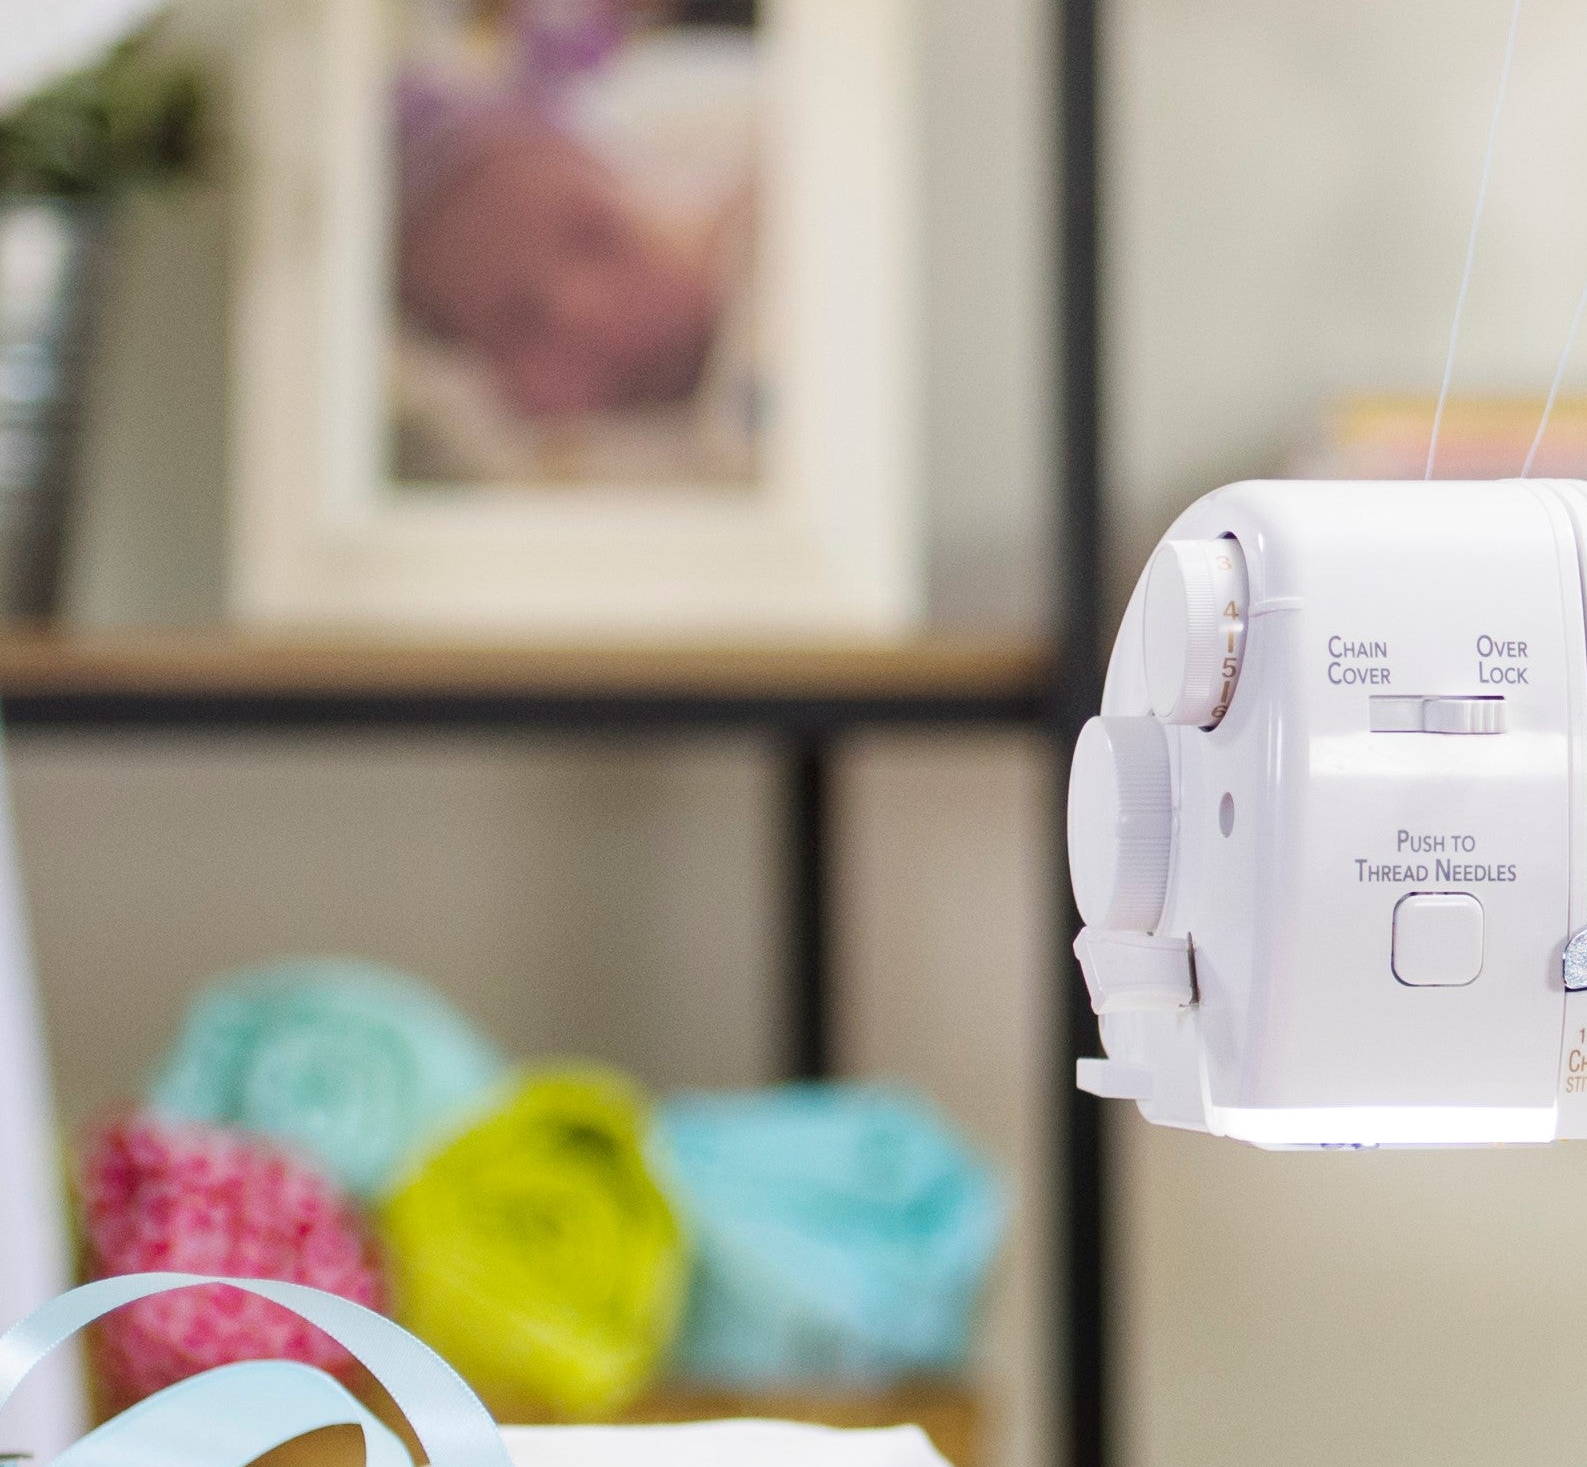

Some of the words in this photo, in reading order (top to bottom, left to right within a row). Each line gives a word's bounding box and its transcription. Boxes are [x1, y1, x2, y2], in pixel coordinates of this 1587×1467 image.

[1216, 555, 1233, 571] 3
[1222, 599, 1240, 621] 4
[1327, 635, 1388, 659] CHAIN
[1475, 634, 1529, 659] OVER
[1221, 657, 1238, 679] 5
[1327, 661, 1392, 685] COVER
[1478, 660, 1529, 684] LOCK
[1210, 704, 1229, 720] 6
[1397, 828, 1446, 854] PUSH
[1451, 834, 1477, 854] TO
[1354, 858, 1430, 883] THREAD
[1434, 858, 1518, 883] NEEDLES
